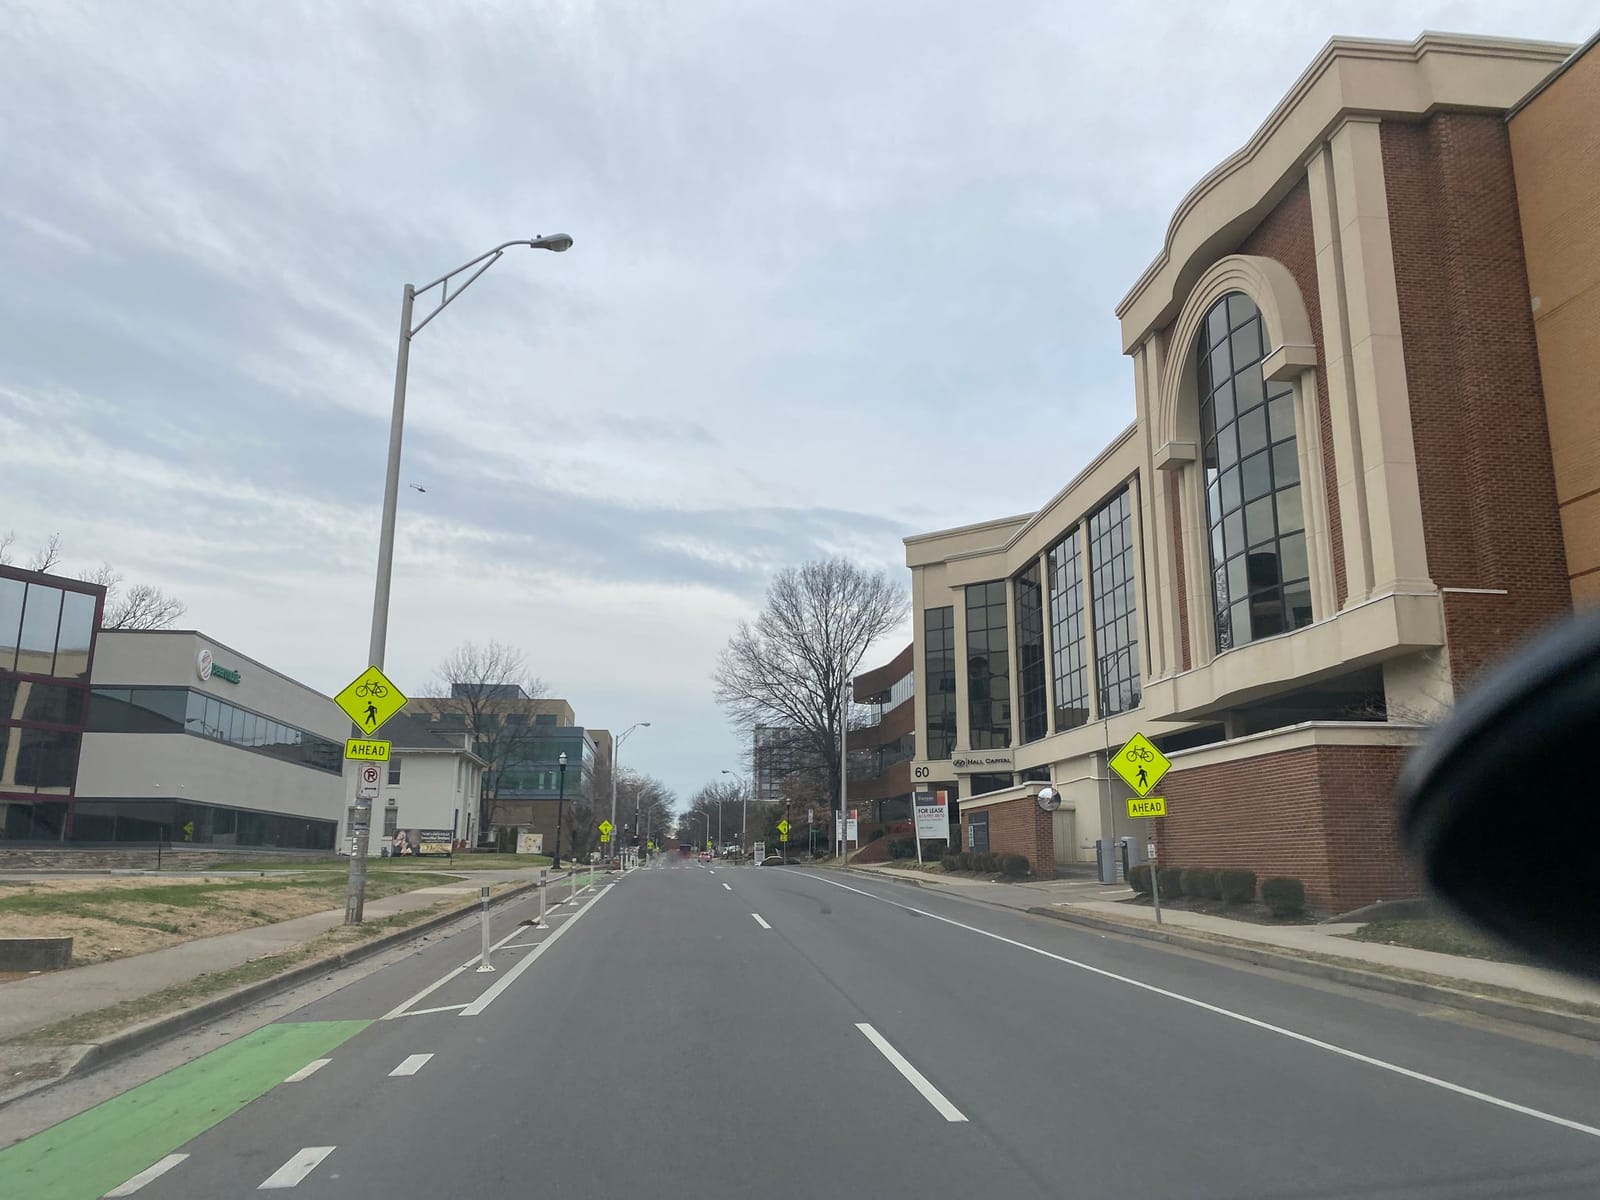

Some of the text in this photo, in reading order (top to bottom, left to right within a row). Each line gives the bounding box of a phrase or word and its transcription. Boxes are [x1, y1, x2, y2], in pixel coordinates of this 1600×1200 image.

[351, 744, 385, 756] AHEAD
[915, 766, 930, 778] 60
[1132, 802, 1162, 813] AHEAD
